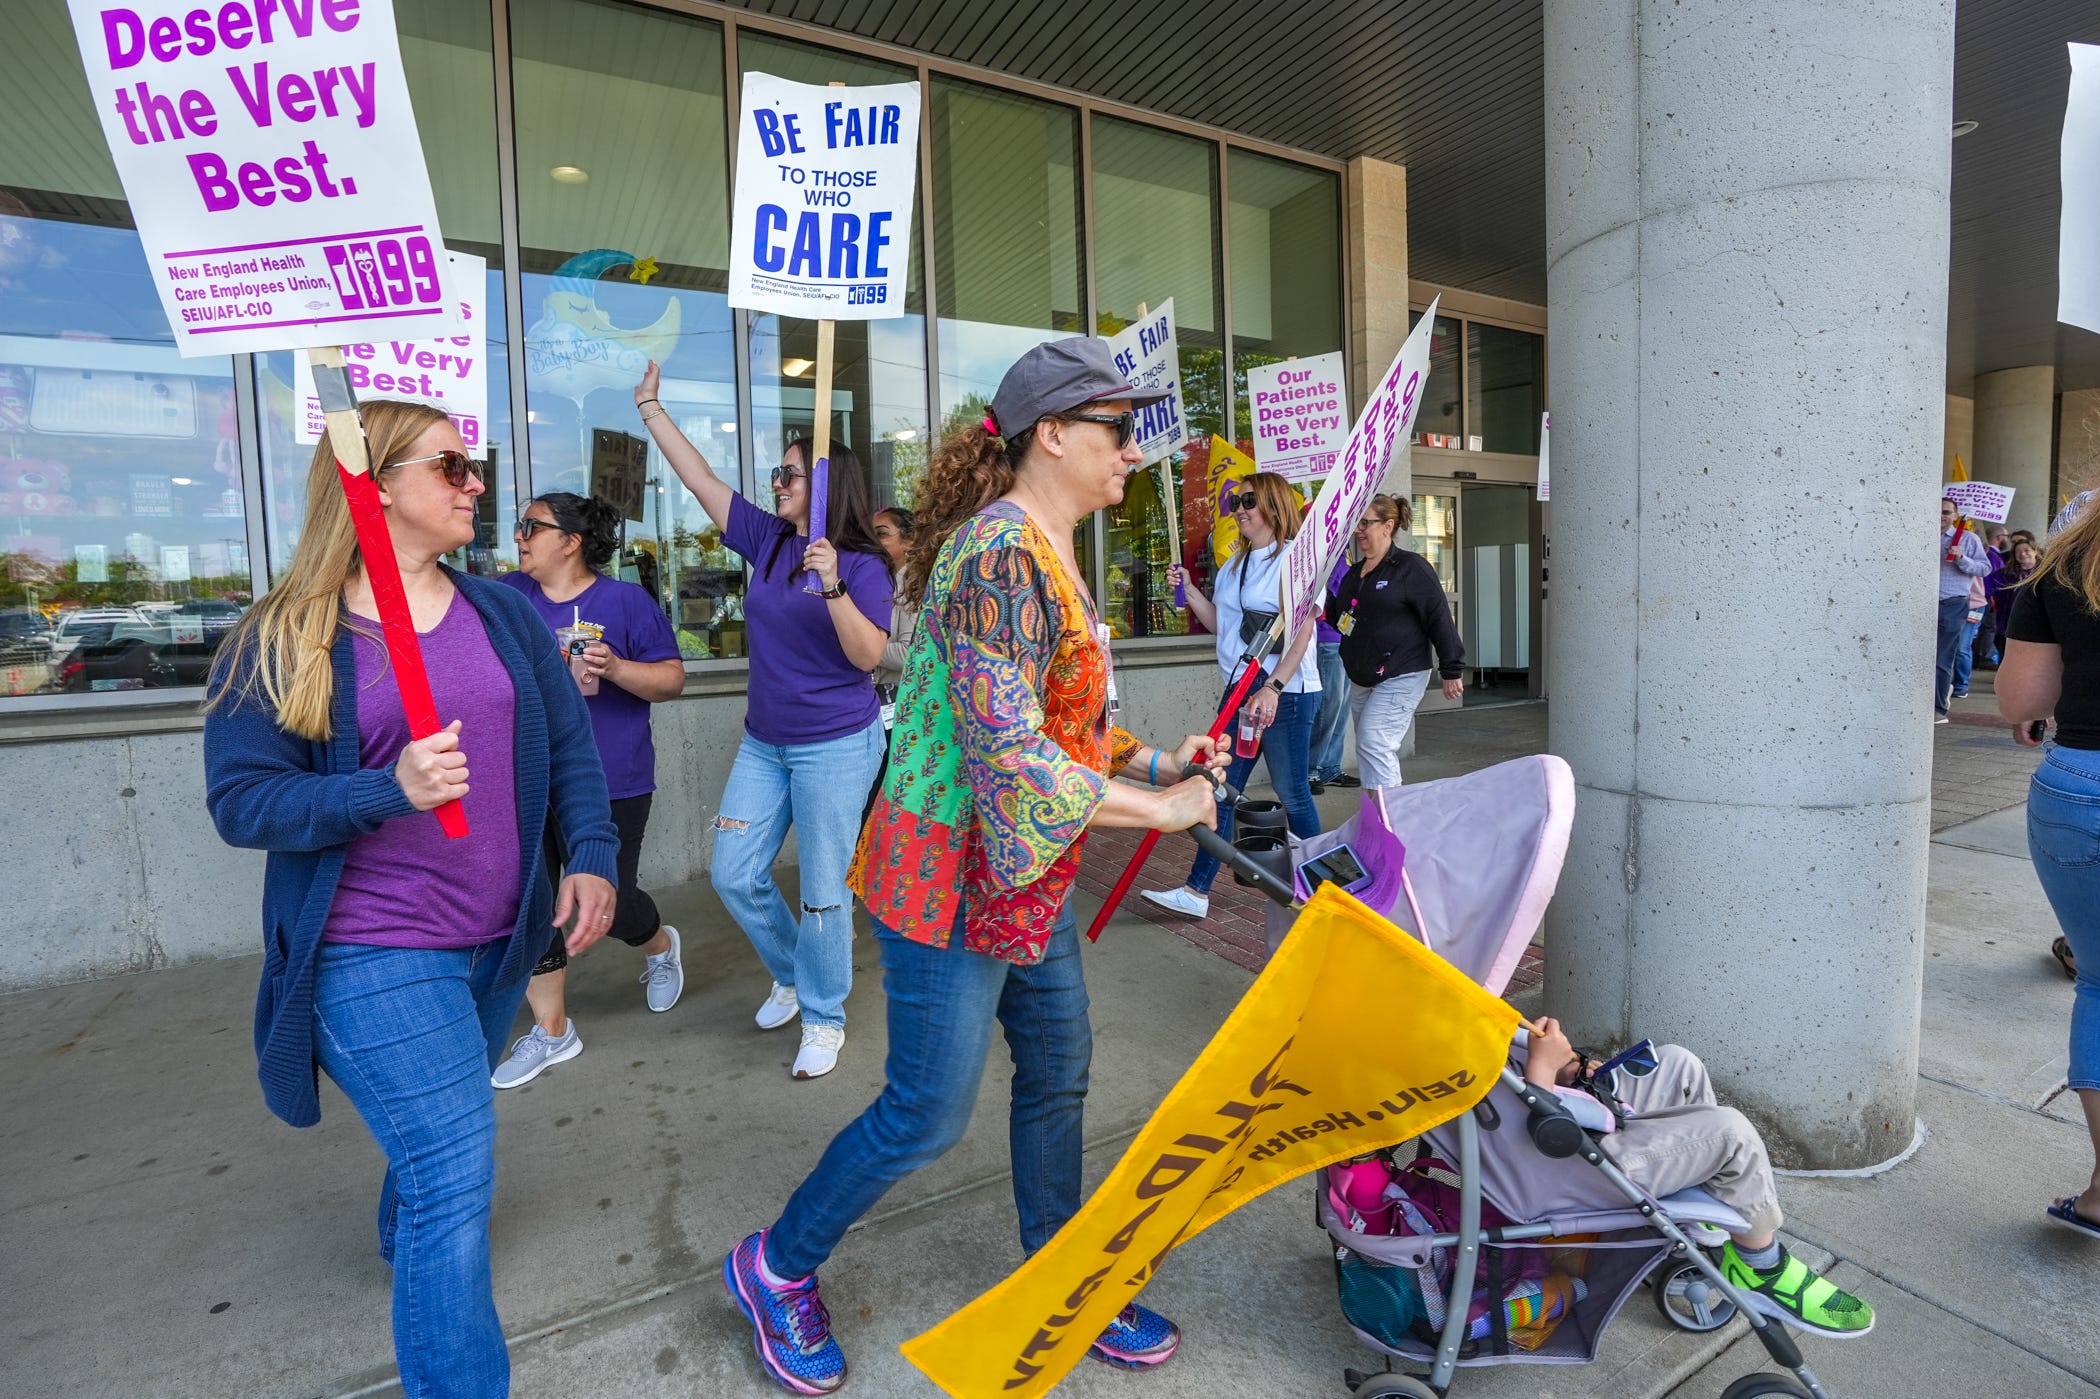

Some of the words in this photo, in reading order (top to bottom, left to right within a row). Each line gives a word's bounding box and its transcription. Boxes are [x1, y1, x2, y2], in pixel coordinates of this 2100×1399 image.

[101, 0, 361, 70] Deserve
[114, 81, 218, 146] the
[226, 61, 376, 129] Very
[753, 108, 806, 158] BE
[824, 101, 901, 150] FAIR
[185, 140, 359, 213] Best.
[778, 165, 805, 185] TO
[811, 170, 877, 188] THOSE
[803, 189, 851, 207] WHO
[753, 203, 892, 279] CARE
[168, 266, 199, 281] New
[203, 258, 259, 278] England
[260, 253, 306, 272] Health
[174, 287, 207, 302] Care
[209, 281, 285, 300] Employees
[287, 275, 332, 292] Union,
[751, 277, 765, 285] New
[765, 279, 789, 289] England
[789, 284, 808, 293] Health
[751, 283, 782, 295] Employees
[390, 341, 473, 379] Very
[532, 350, 572, 371] Baby
[571, 340, 609, 361] Boy
[1114, 347, 1137, 378] BE
[1139, 316, 1169, 358] FAIR
[349, 363, 443, 398] Best.
[1142, 359, 1167, 382] THOSE
[1277, 370, 1312, 385] Our
[1256, 381, 1337, 406] Patients
[1400, 370, 1419, 434] Our
[1258, 399, 1338, 422] Deserve
[1258, 423, 1290, 438] the
[1296, 415, 1340, 432] Very
[1276, 433, 1326, 452] Best.
[1344, 430, 1360, 496] the
[1946, 492, 2005, 503] Deserve
[1947, 487, 2006, 499] Patients
[1973, 498, 2004, 508] Very
